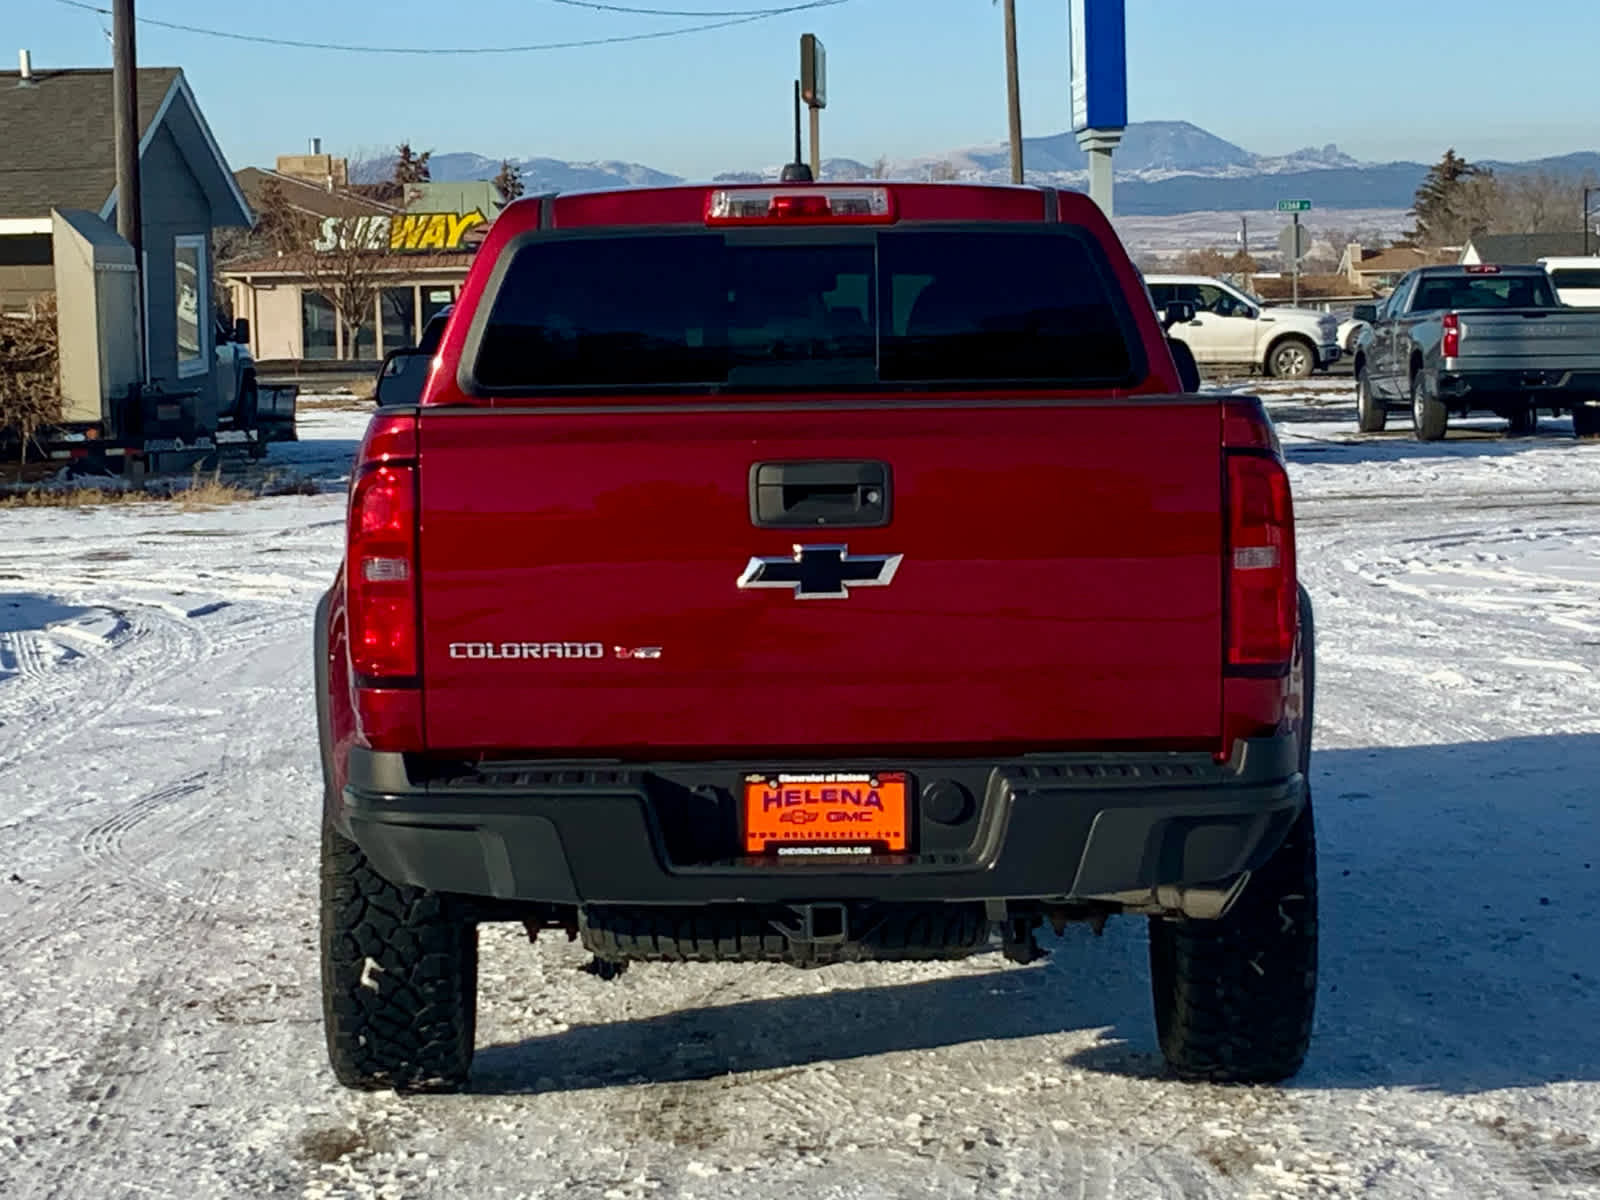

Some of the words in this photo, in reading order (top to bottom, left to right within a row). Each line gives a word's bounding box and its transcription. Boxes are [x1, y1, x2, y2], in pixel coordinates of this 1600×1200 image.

[314, 208, 487, 252] SUBWAY
[449, 642, 604, 659] COLORADO
[763, 788, 884, 813] HELENA
[826, 811, 873, 822] GMC
